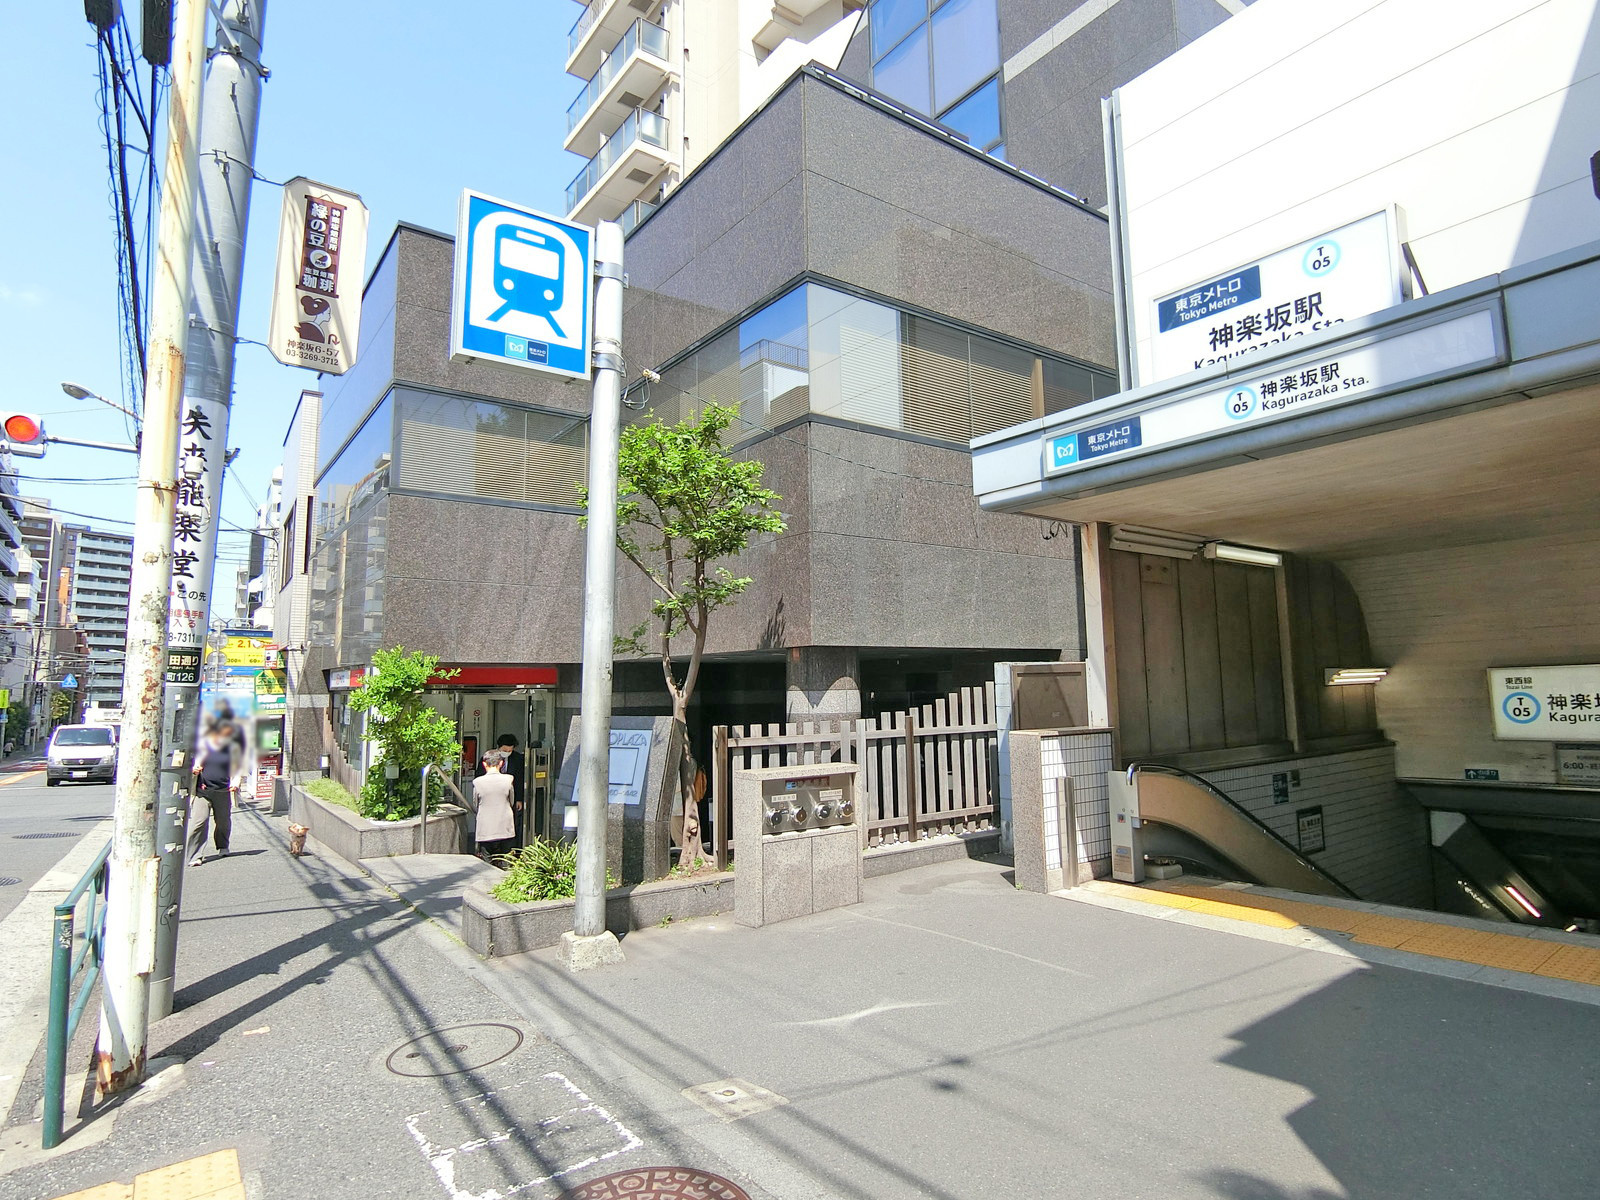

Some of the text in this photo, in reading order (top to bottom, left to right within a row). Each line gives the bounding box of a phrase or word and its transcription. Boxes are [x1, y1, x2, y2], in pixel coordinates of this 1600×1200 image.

[1317, 246, 1325, 257] T
[1312, 256, 1331, 271] 05
[302, 273, 335, 292] 珈琲
[1174, 277, 1241, 313] 東京メトロ
[1179, 295, 1238, 323] Tokyo Metro
[1208, 291, 1324, 352] 神楽坂駅
[285, 348, 339, 366] 03-3269-3712
[287, 339, 340, 358] 神楽坂6-57
[1260, 362, 1340, 399] 神楽坂駅
[1236, 392, 1242, 402] T
[1261, 374, 1370, 411] Kagurazaka Sta.
[1232, 401, 1249, 414] 05
[1087, 426, 1130, 446] 東京メトロ
[1090, 436, 1128, 453] Tokyo Metro
[177, 590, 206, 601] この先
[1505, 676, 1533, 685] 東西線
[1517, 697, 1524, 706] T
[1512, 707, 1531, 717] 05
[1549, 711, 1600, 725] Kagura
